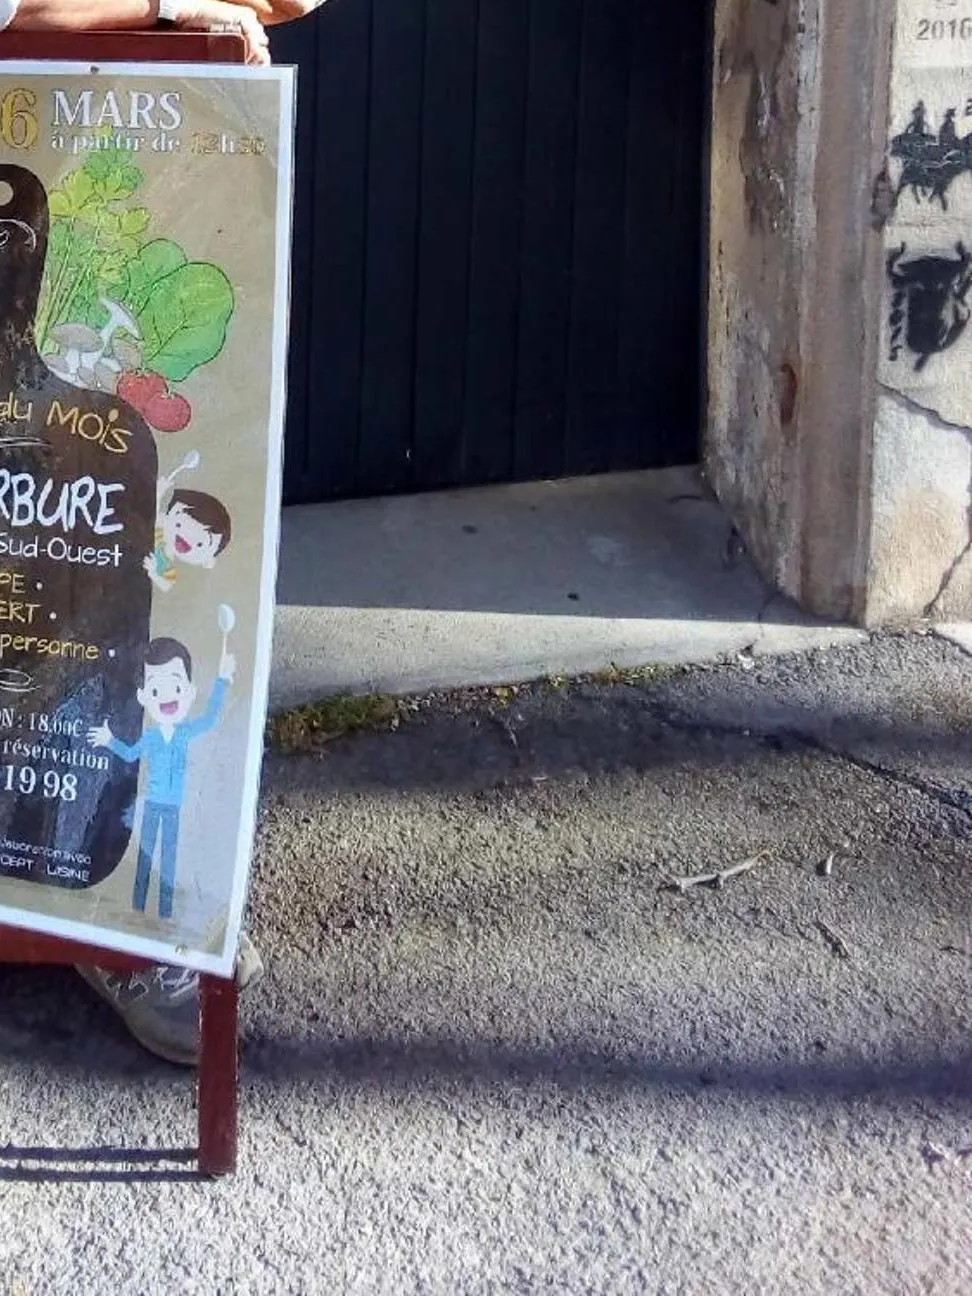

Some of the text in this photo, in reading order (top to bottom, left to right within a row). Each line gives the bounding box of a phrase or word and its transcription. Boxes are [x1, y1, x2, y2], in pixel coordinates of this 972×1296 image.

[51, 90, 184, 130] MARS
[71, 133, 145, 154] partir
[152, 133, 180, 152] de
[0, 632, 100, 660] personne
[3, 737, 109, 770] réservation
[4, 764, 36, 794] 19
[43, 770, 78, 801] 98
